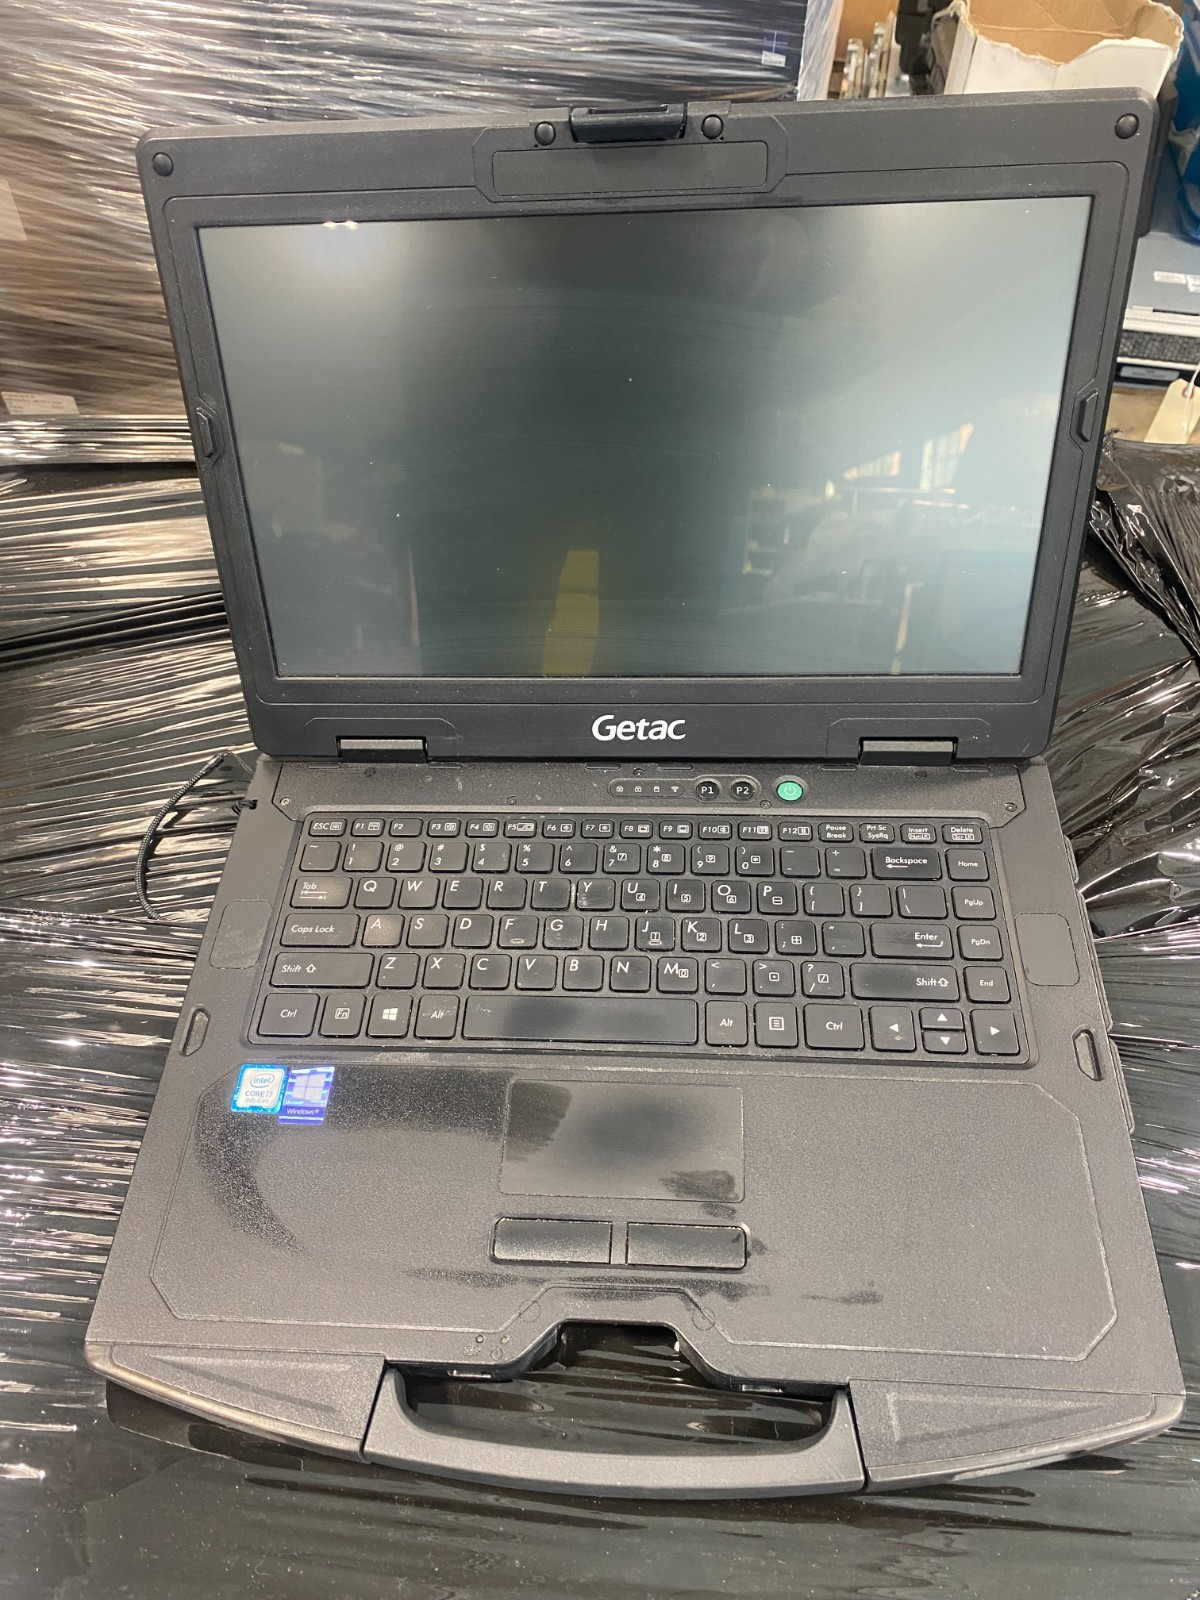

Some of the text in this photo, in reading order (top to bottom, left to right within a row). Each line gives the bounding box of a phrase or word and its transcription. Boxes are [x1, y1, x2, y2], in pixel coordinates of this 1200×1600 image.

[592, 715, 686, 741] Getac
[701, 786, 714, 795] P1
[736, 787, 749, 795] P2
[653, 860, 659, 868] 8
[302, 882, 317, 891] Tab
[363, 881, 377, 893] Q
[407, 881, 422, 892] W
[450, 881, 459, 892] E
[494, 881, 503, 892] R
[538, 881, 547, 892] T
[583, 882, 592, 892] Y
[628, 883, 638, 893] U
[673, 884, 677, 894] I
[718, 885, 731, 895] O
[763, 886, 772, 896] P
[809, 887, 814, 895] {
[857, 887, 862, 896] }
[370, 918, 381, 929] A
[414, 918, 423, 930] S
[460, 918, 471, 930] D
[504, 919, 513, 930] F
[550, 919, 564, 931] G
[596, 920, 607, 931] H
[642, 921, 649, 932] J
[687, 922, 698, 933] K
[734, 923, 742, 934] L
[291, 925, 335, 934] Caps Lock
[914, 932, 938, 940] Enter
[385, 957, 395, 969] Z
[430, 958, 441, 969] X
[477, 958, 488, 970] C
[525, 959, 536, 970] V
[569, 959, 579, 971] B
[617, 962, 629, 973] N
[281, 964, 301, 974] Shift
[664, 963, 679, 974] M
[808, 964, 814, 973] ?
[916, 978, 936, 986] Shift
[809, 983, 816, 992] /
[280, 1009, 297, 1019] Ctrl
[336, 1009, 348, 1019] Fn
[430, 1010, 444, 1019] Alt
[720, 1018, 733, 1027] Alt
[825, 1022, 843, 1031] Ctrl
